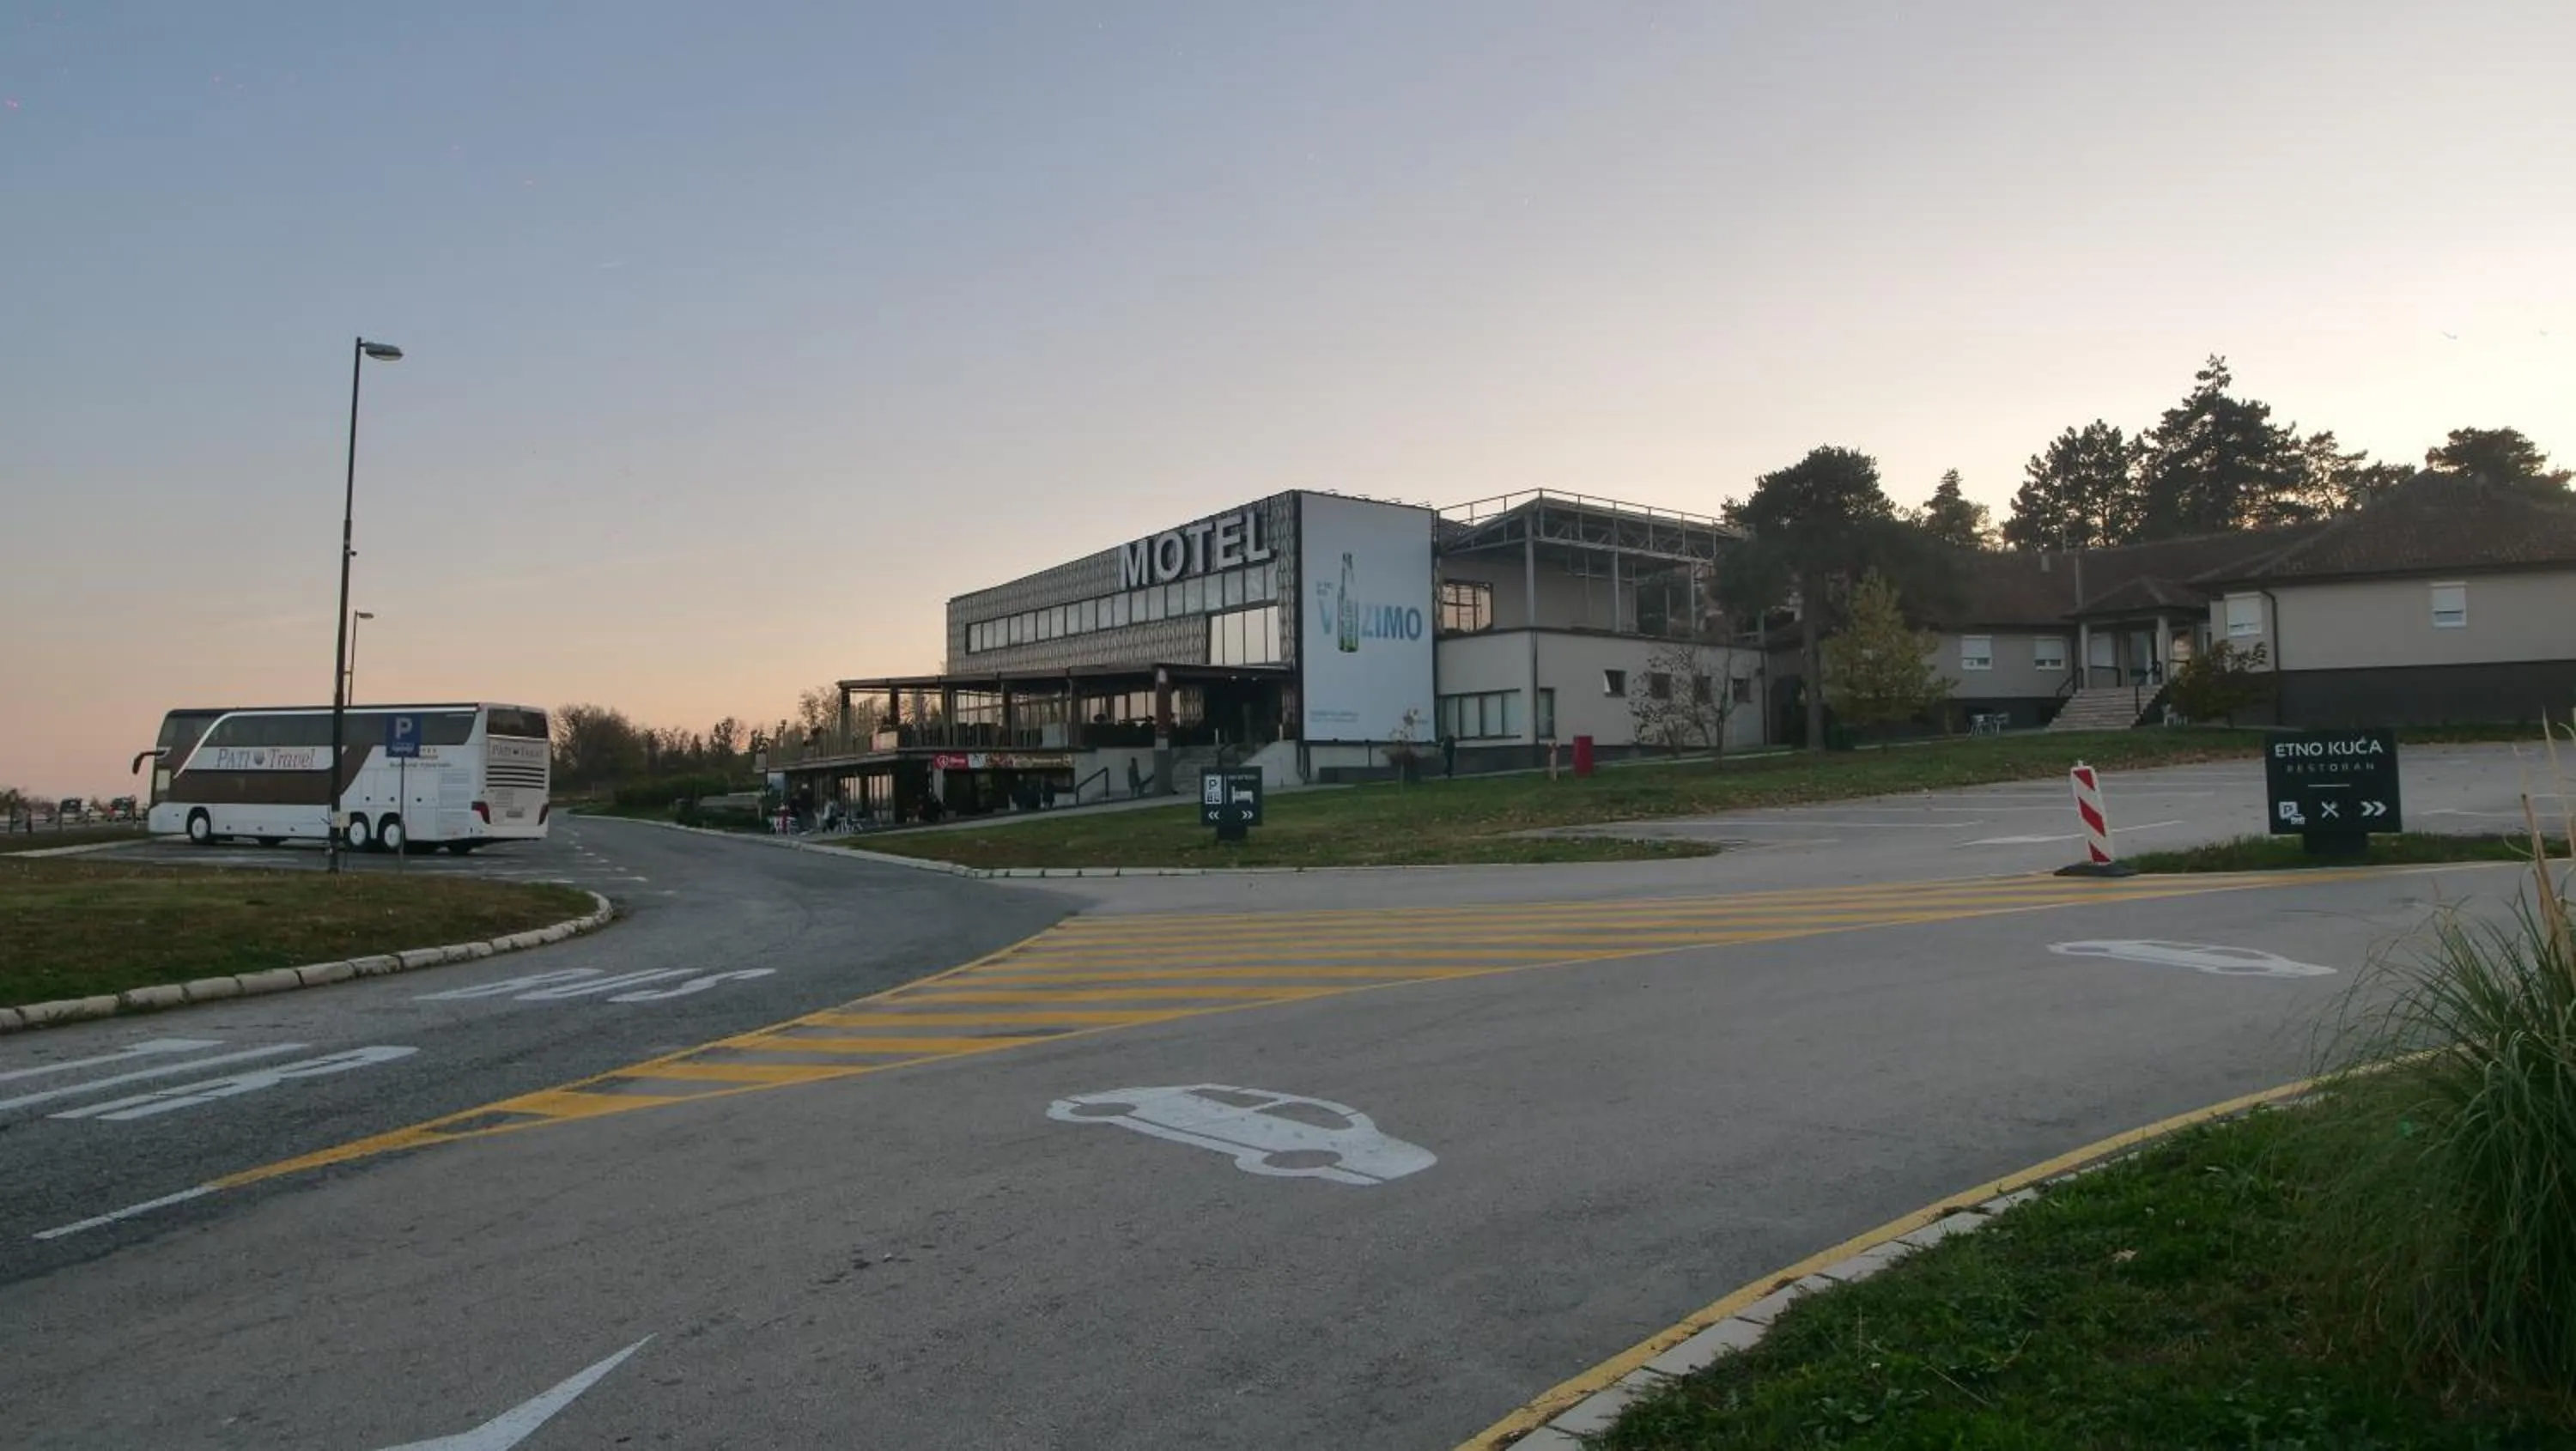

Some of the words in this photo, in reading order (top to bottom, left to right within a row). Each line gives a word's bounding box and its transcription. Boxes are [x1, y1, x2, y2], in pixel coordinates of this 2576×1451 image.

[1117, 512, 1270, 591] MOTEL
[396, 716, 413, 739] P
[2275, 742, 2323, 757] ETNO
[2328, 737, 2383, 756] KUĆA
[269, 748, 315, 768] Travel
